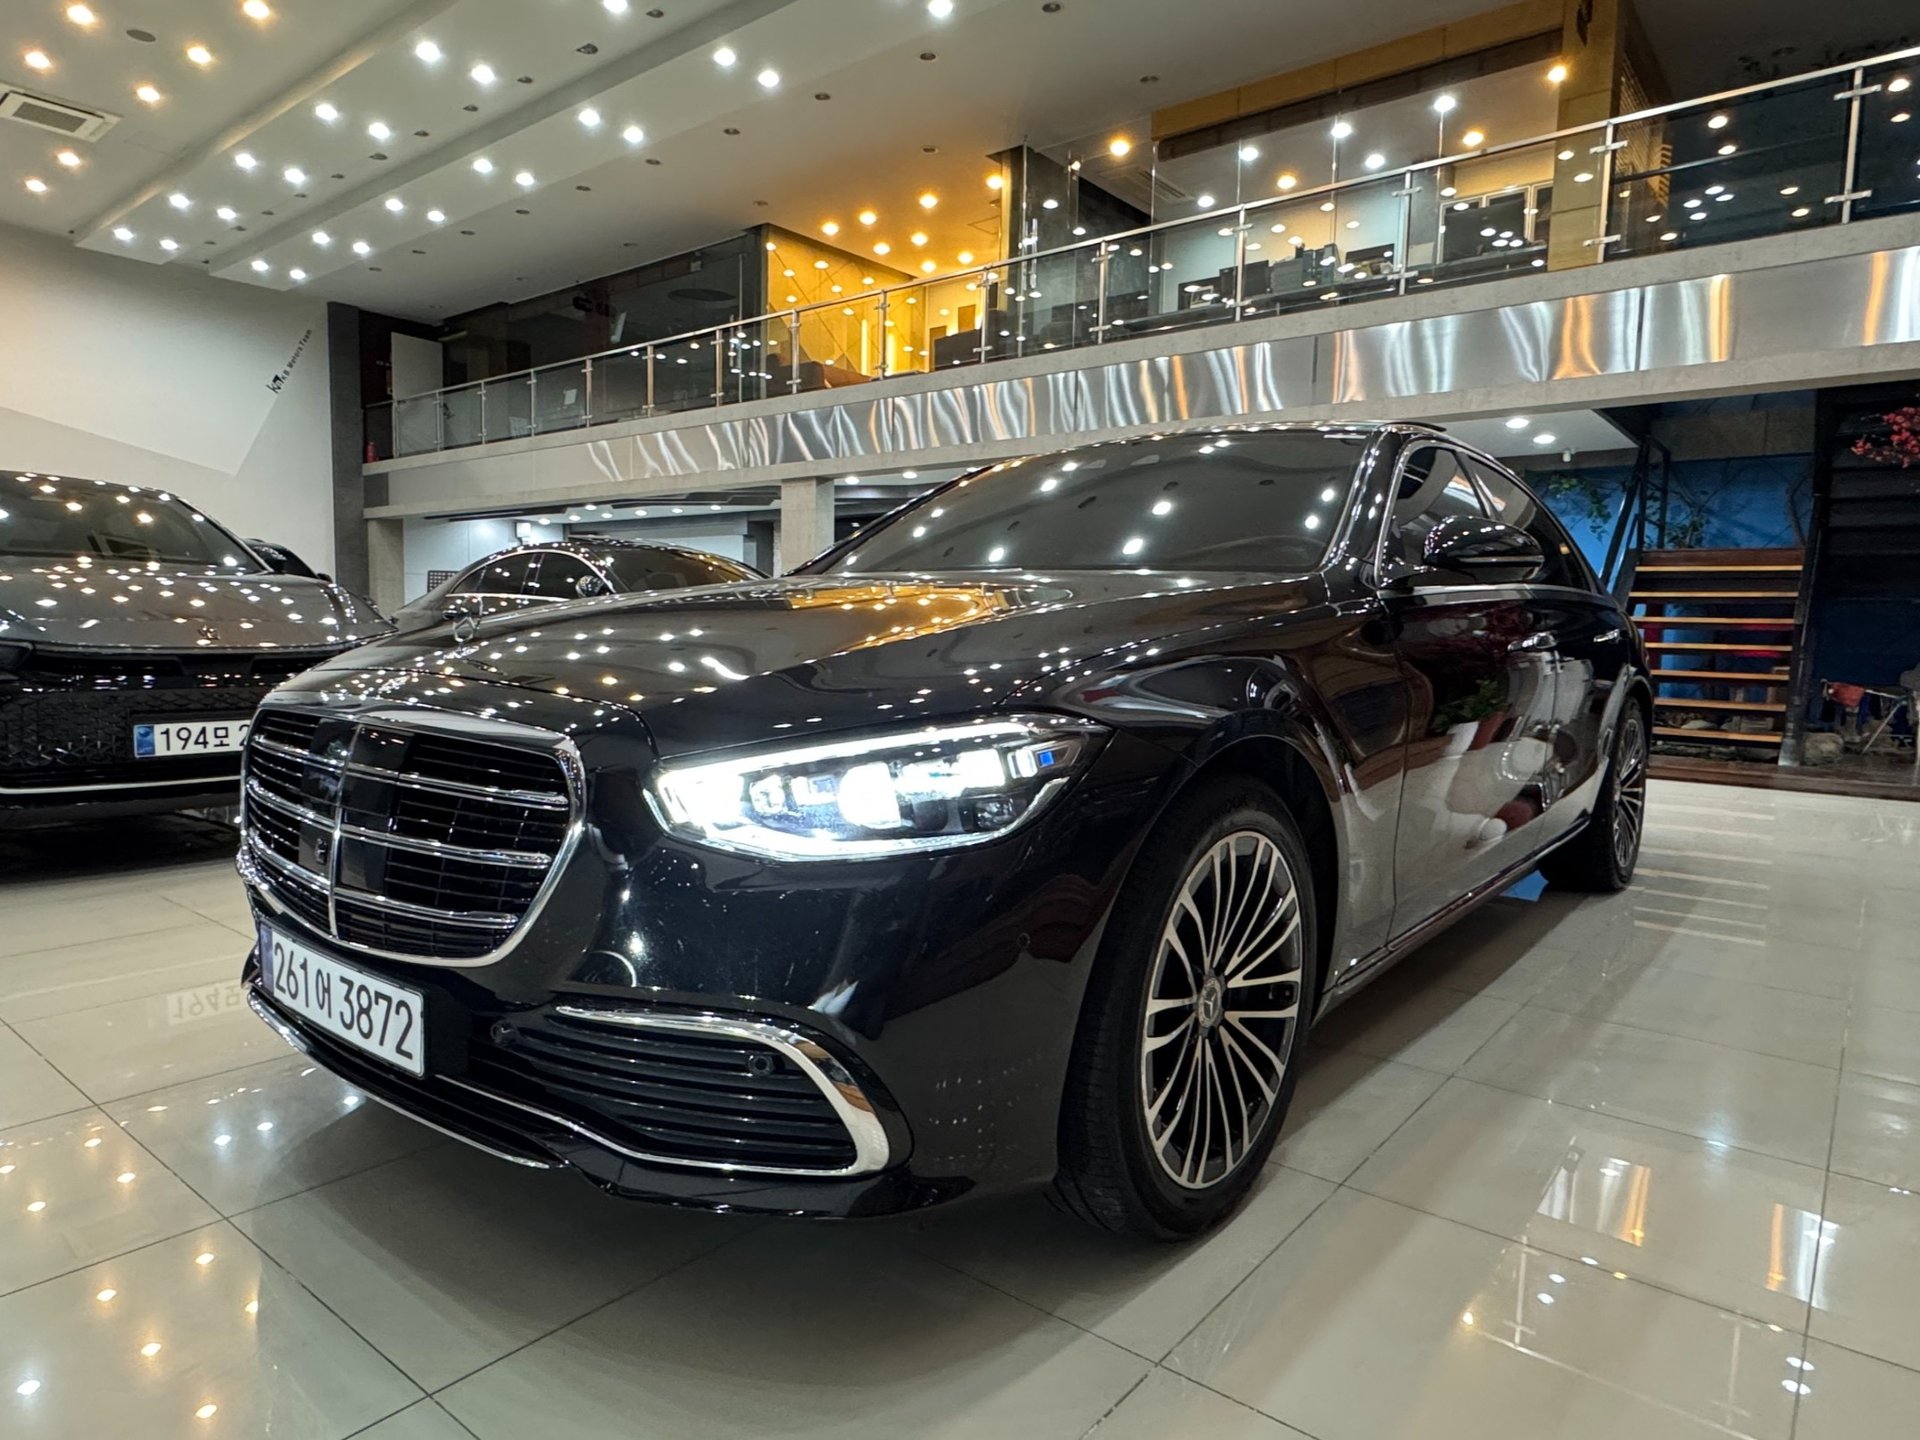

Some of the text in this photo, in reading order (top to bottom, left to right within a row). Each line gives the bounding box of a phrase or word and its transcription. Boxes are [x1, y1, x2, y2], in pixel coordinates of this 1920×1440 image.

[160, 726, 230, 751] 194모
[274, 942, 413, 1060] 261어 3872
